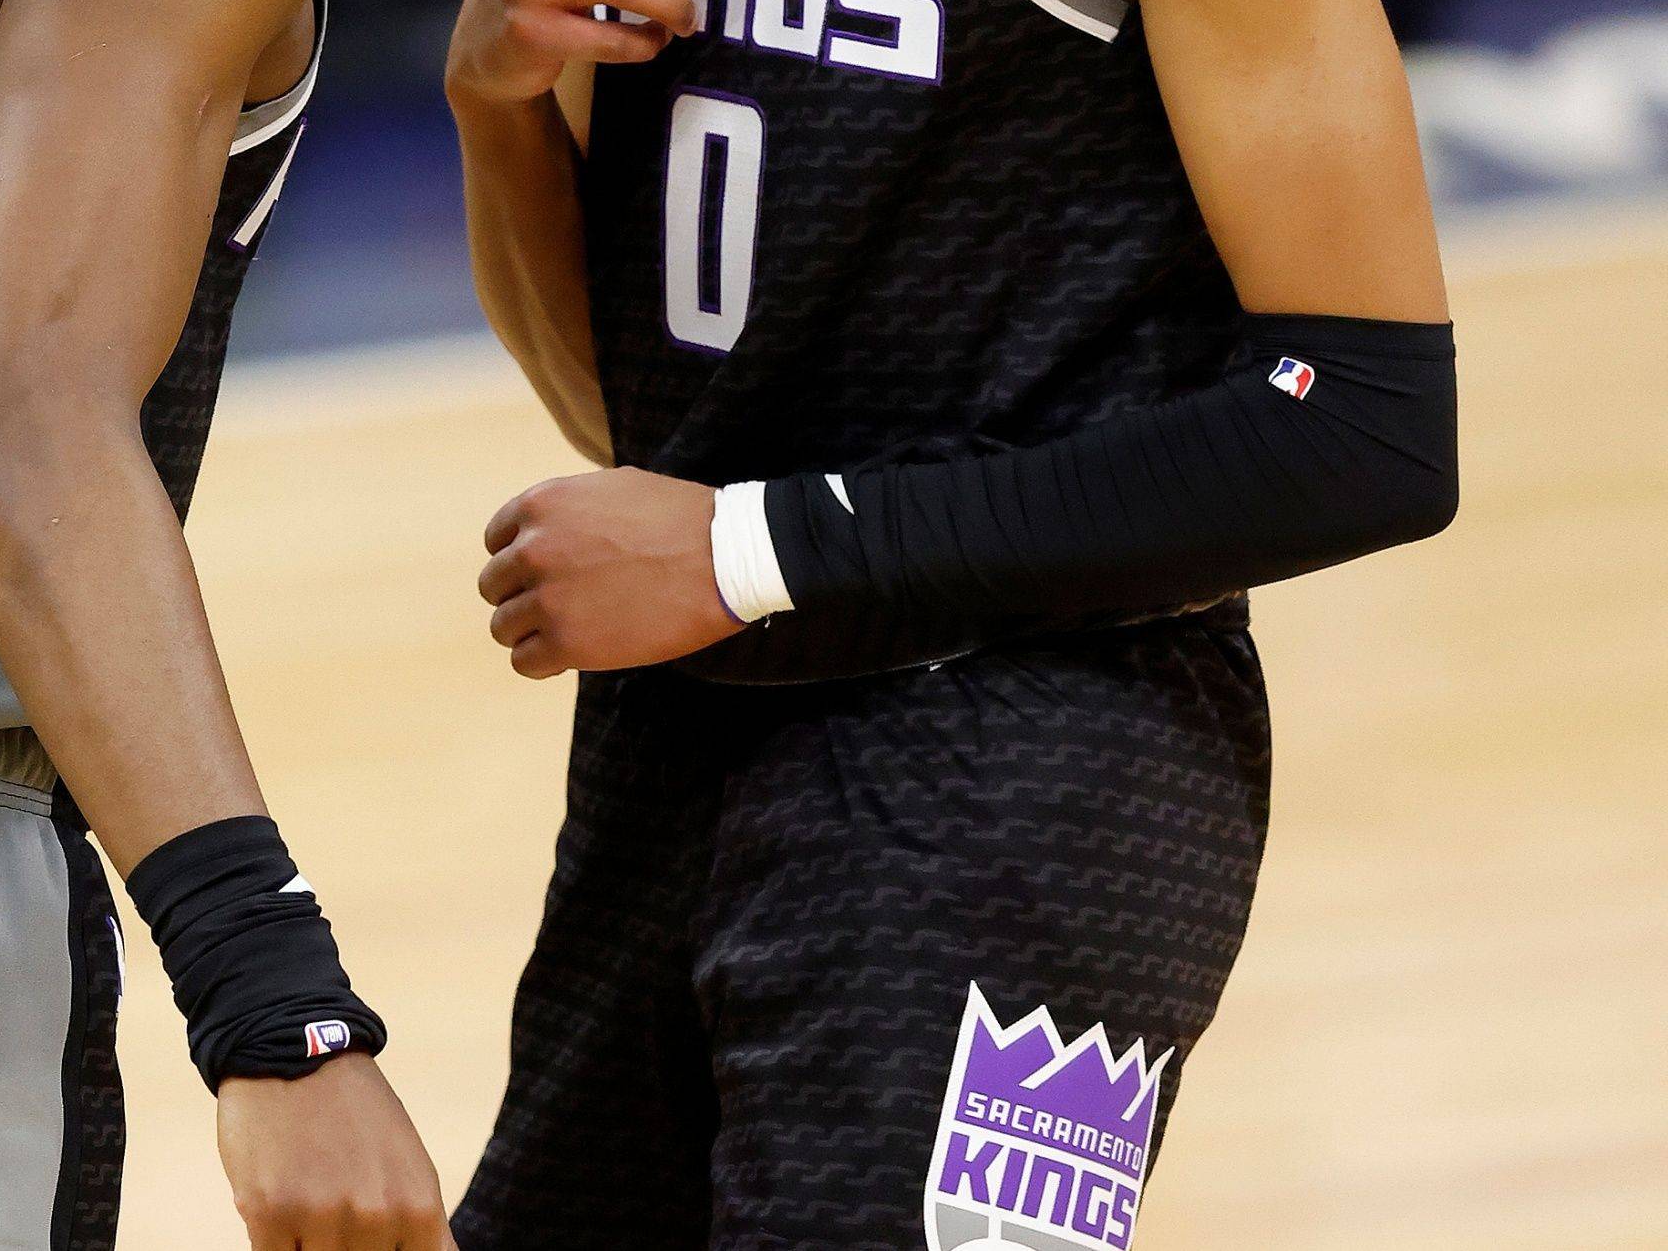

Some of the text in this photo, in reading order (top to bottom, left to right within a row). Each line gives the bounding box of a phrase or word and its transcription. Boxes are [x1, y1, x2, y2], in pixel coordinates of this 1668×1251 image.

[662, 86, 767, 357] 0
[938, 1130, 1137, 1251] KINGS
[964, 1091, 1143, 1172] SACRAMENTO
